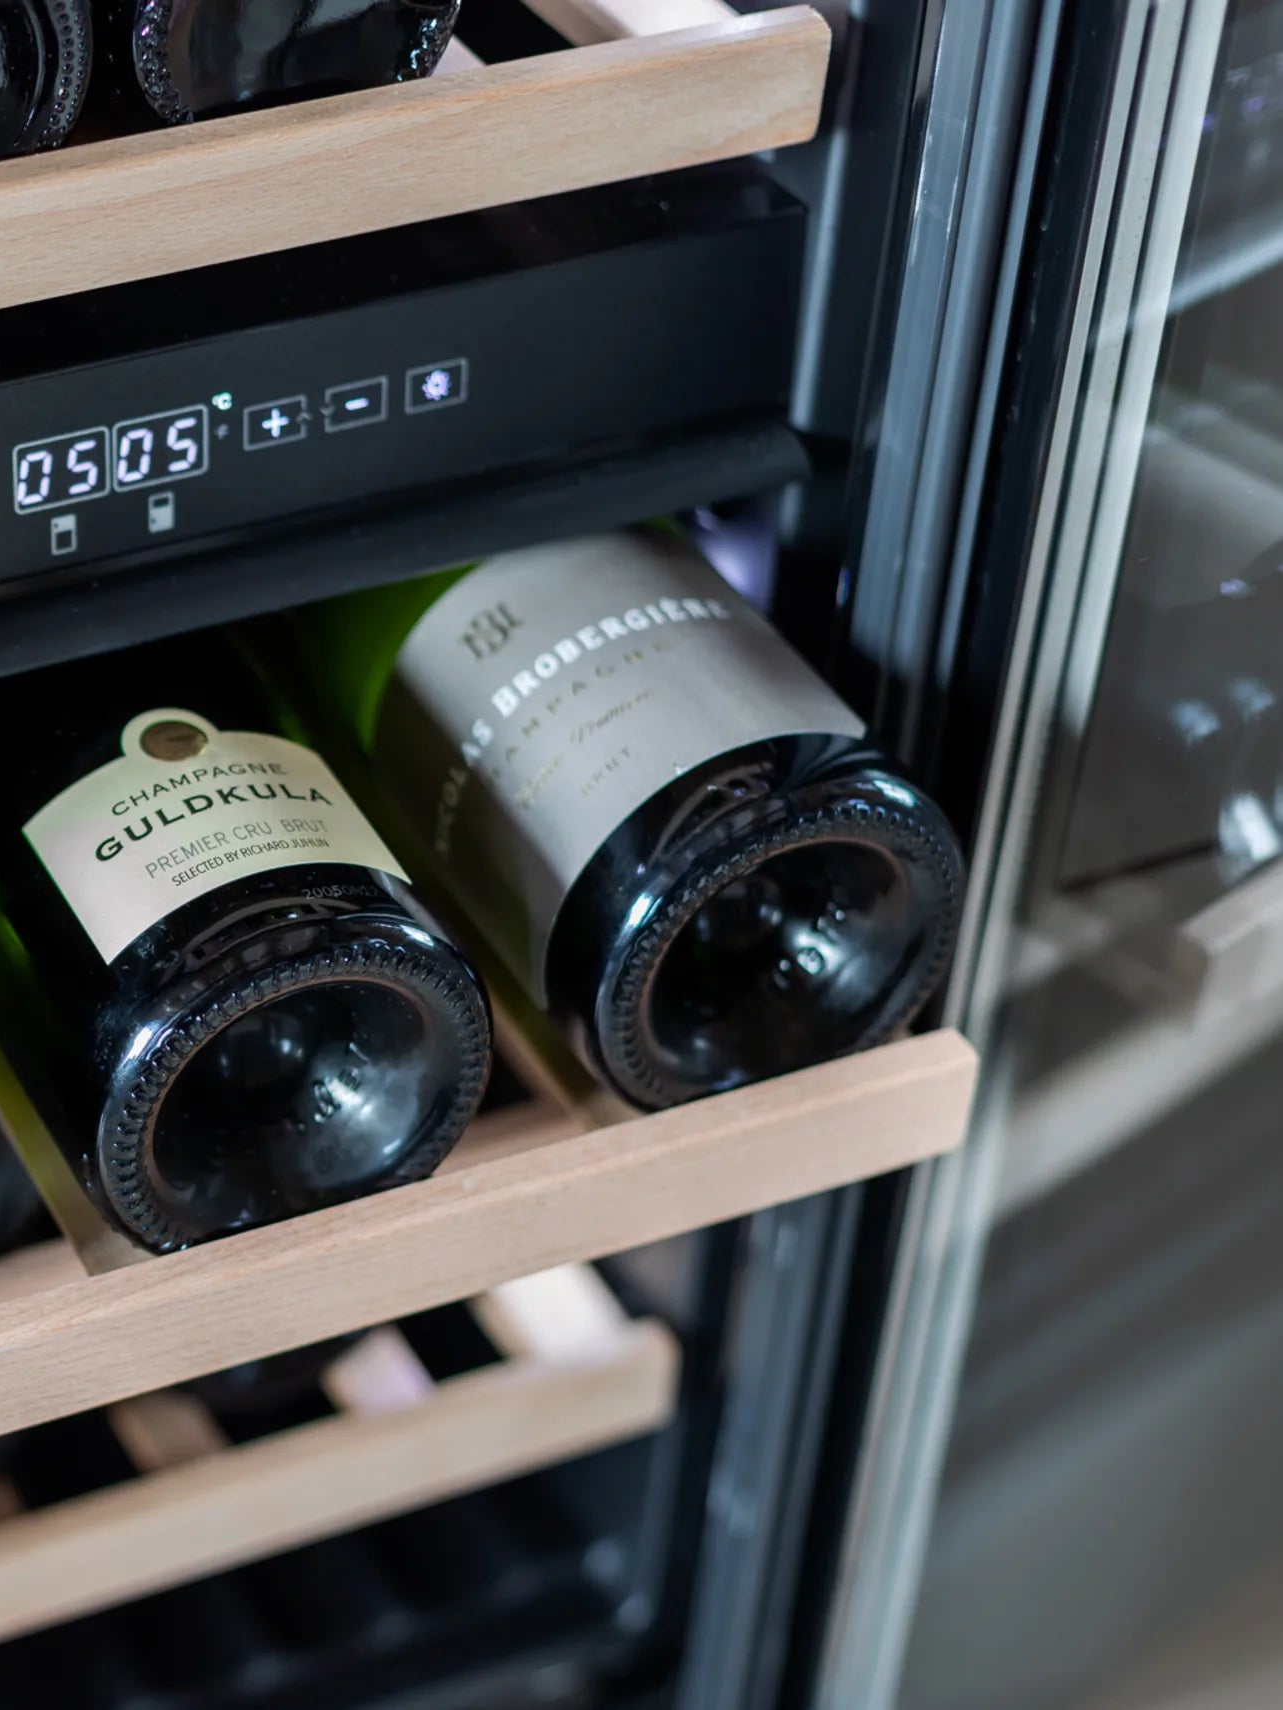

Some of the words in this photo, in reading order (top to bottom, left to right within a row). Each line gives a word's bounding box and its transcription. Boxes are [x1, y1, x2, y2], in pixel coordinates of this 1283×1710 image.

[111, 761, 288, 817] CHAMPAGNE
[95, 783, 333, 861] GULDKULA
[145, 832, 230, 879] PREMIER
[233, 821, 272, 841] CRU
[280, 819, 328, 834] BRUT
[171, 856, 224, 887] SELECTED
[224, 850, 241, 862] BY
[241, 839, 289, 858] RICHARD
